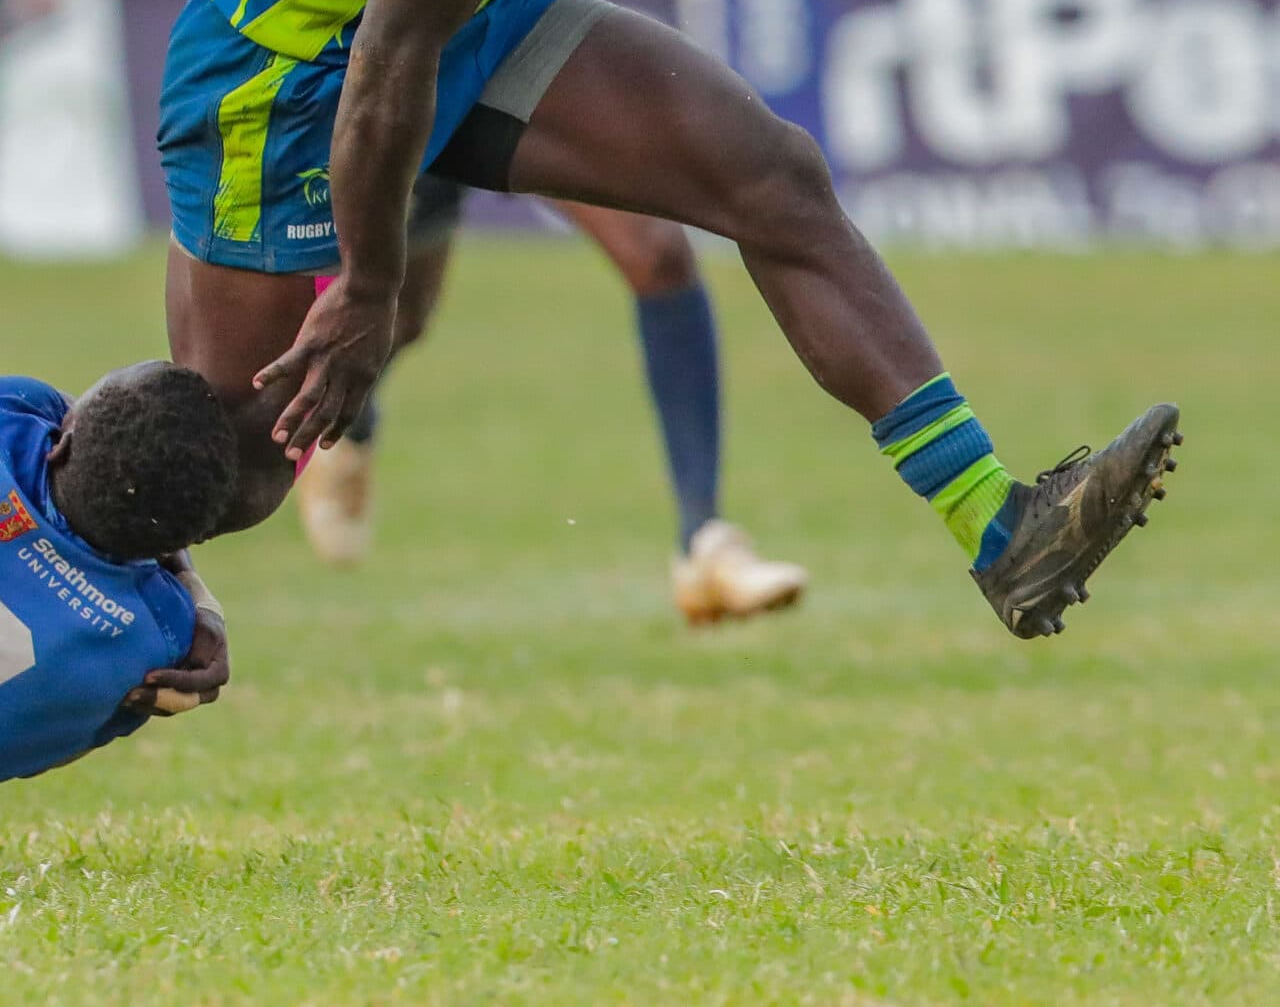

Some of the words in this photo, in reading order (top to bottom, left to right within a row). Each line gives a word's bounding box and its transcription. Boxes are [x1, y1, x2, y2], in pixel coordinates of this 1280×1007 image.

[286, 222, 332, 240] RUGBY
[18, 547, 124, 638] UNIVERSITY
[32, 537, 136, 626] Strathmore
